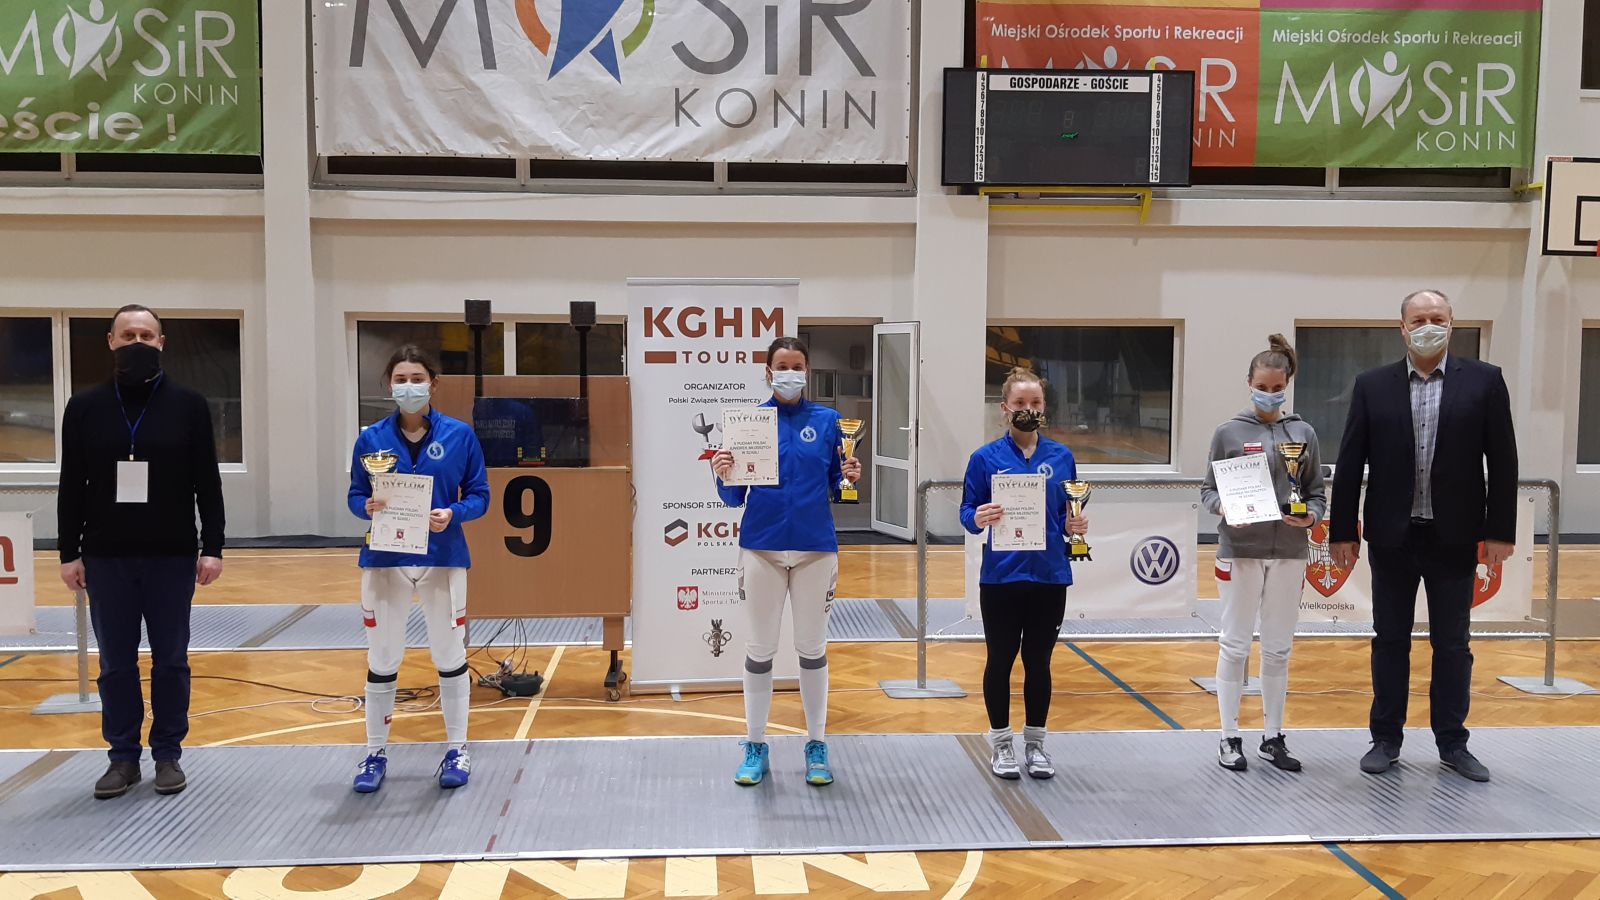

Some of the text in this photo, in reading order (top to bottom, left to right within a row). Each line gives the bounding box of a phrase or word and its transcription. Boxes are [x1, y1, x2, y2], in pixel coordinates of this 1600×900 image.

[991, 23, 1244, 43] Miejski Ośrodek Sportu i Rekreacji
[1272, 28, 1522, 47] Miejski Ośrodek Sportu i Rekreacji
[1009, 76, 1080, 89] GOSPODARZE
[1091, 75, 1129, 90] GOŚCIE
[133, 83, 238, 105] KONIN
[674, 87, 876, 130] KONIN
[167, 113, 177, 141] !
[976, 127, 984, 136] 10
[1152, 128, 1160, 137] 10
[975, 136, 984, 144] 11
[1152, 137, 1159, 145] 11
[1416, 131, 1516, 151] KONIN
[975, 145, 984, 153] 12
[1151, 146, 1159, 154] 12
[975, 154, 983, 162] 13
[1151, 155, 1159, 163] 13
[975, 163, 983, 171] 14
[1150, 163, 1159, 172] 14
[975, 172, 983, 180] 15
[1150, 172, 1158, 181] 15
[643, 306, 784, 338] KGHM
[682, 351, 747, 364] TOUR
[683, 382, 746, 391] ORGANIZATOR
[668, 396, 762, 406] Polski Związek Szermierczy
[729, 413, 770, 424] DYPLOM
[1220, 461, 1260, 474] DYPLOM
[382, 480, 425, 491] DYPLOM
[998, 480, 1038, 489] DYPLOM
[662, 502, 704, 510] SPONSOR
[503, 475, 553, 558] 9
[1299, 602, 1355, 611] Wielkopolska
